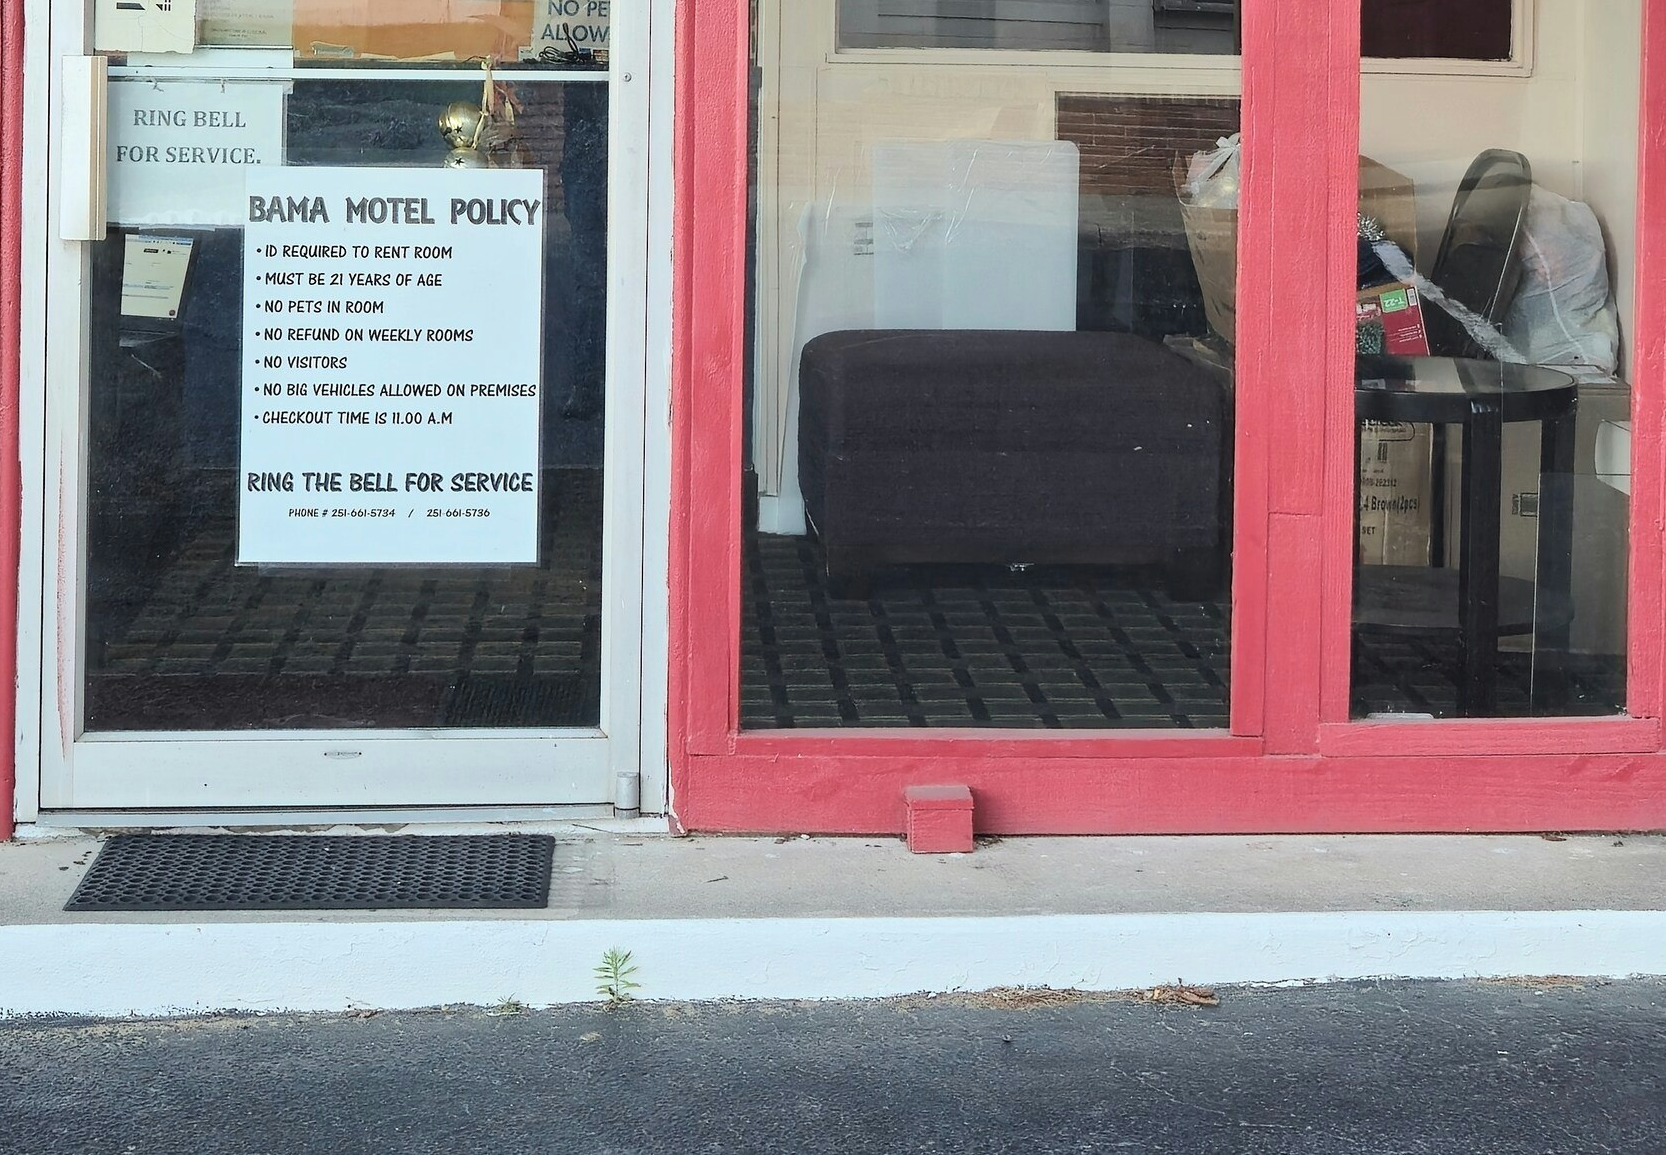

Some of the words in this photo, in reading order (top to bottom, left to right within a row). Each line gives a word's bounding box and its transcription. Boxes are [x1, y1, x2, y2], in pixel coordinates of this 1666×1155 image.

[587, 1, 610, 17] PE
[133, 110, 186, 127] RING
[194, 111, 246, 127] BELL
[116, 145, 159, 163] FOR
[166, 147, 261, 164] SERVICE.
[249, 196, 330, 223] BAMA
[346, 197, 435, 224] MOTEL
[451, 199, 540, 225] POLICY
[265, 245, 277, 257] ID
[283, 245, 346, 259] REQUIRED
[352, 246, 369, 258] TO
[375, 246, 410, 258] RENT
[415, 246, 452, 259] ROOM
[265, 272, 304, 285] MUST
[309, 273, 325, 285] BE
[330, 273, 343, 285] 21
[349, 273, 390, 286] YEARS
[396, 273, 412, 286] OF
[417, 274, 442, 286] AGE
[265, 300, 282, 313] NO
[289, 301, 322, 313] PETS
[328, 301, 340, 313] IN
[346, 301, 383, 313] ROOM
[264, 328, 282, 340] NO
[288, 328, 339, 341] REFUND
[345, 329, 363, 341] ON
[369, 329, 422, 341] WEEKLY
[427, 329, 473, 341] ROOMS
[264, 356, 282, 368] NO
[288, 356, 347, 368] VISITORS
[264, 383, 281, 396] NO
[287, 383, 307, 396] BIG
[313, 384, 375, 396] VEHICLES
[380, 384, 441, 396] ALLOWED
[447, 384, 465, 396] ON
[471, 384, 536, 396] PREMISES
[263, 411, 333, 424] CHECKOUT
[337, 411, 370, 424] TIME
[375, 412, 387, 424] IS
[393, 412, 422, 424] 11.00
[428, 412, 452, 424] A.M
[248, 472, 293, 492] RING
[302, 473, 342, 492] THE
[350, 473, 398, 492] BELL
[405, 472, 443, 492] FOR
[451, 473, 533, 492] SERVICE
[289, 508, 319, 517] PHONE
[322, 509, 328, 517] #
[331, 508, 395, 517] 251-661-5734
[427, 508, 490, 517] 251-661-5736
